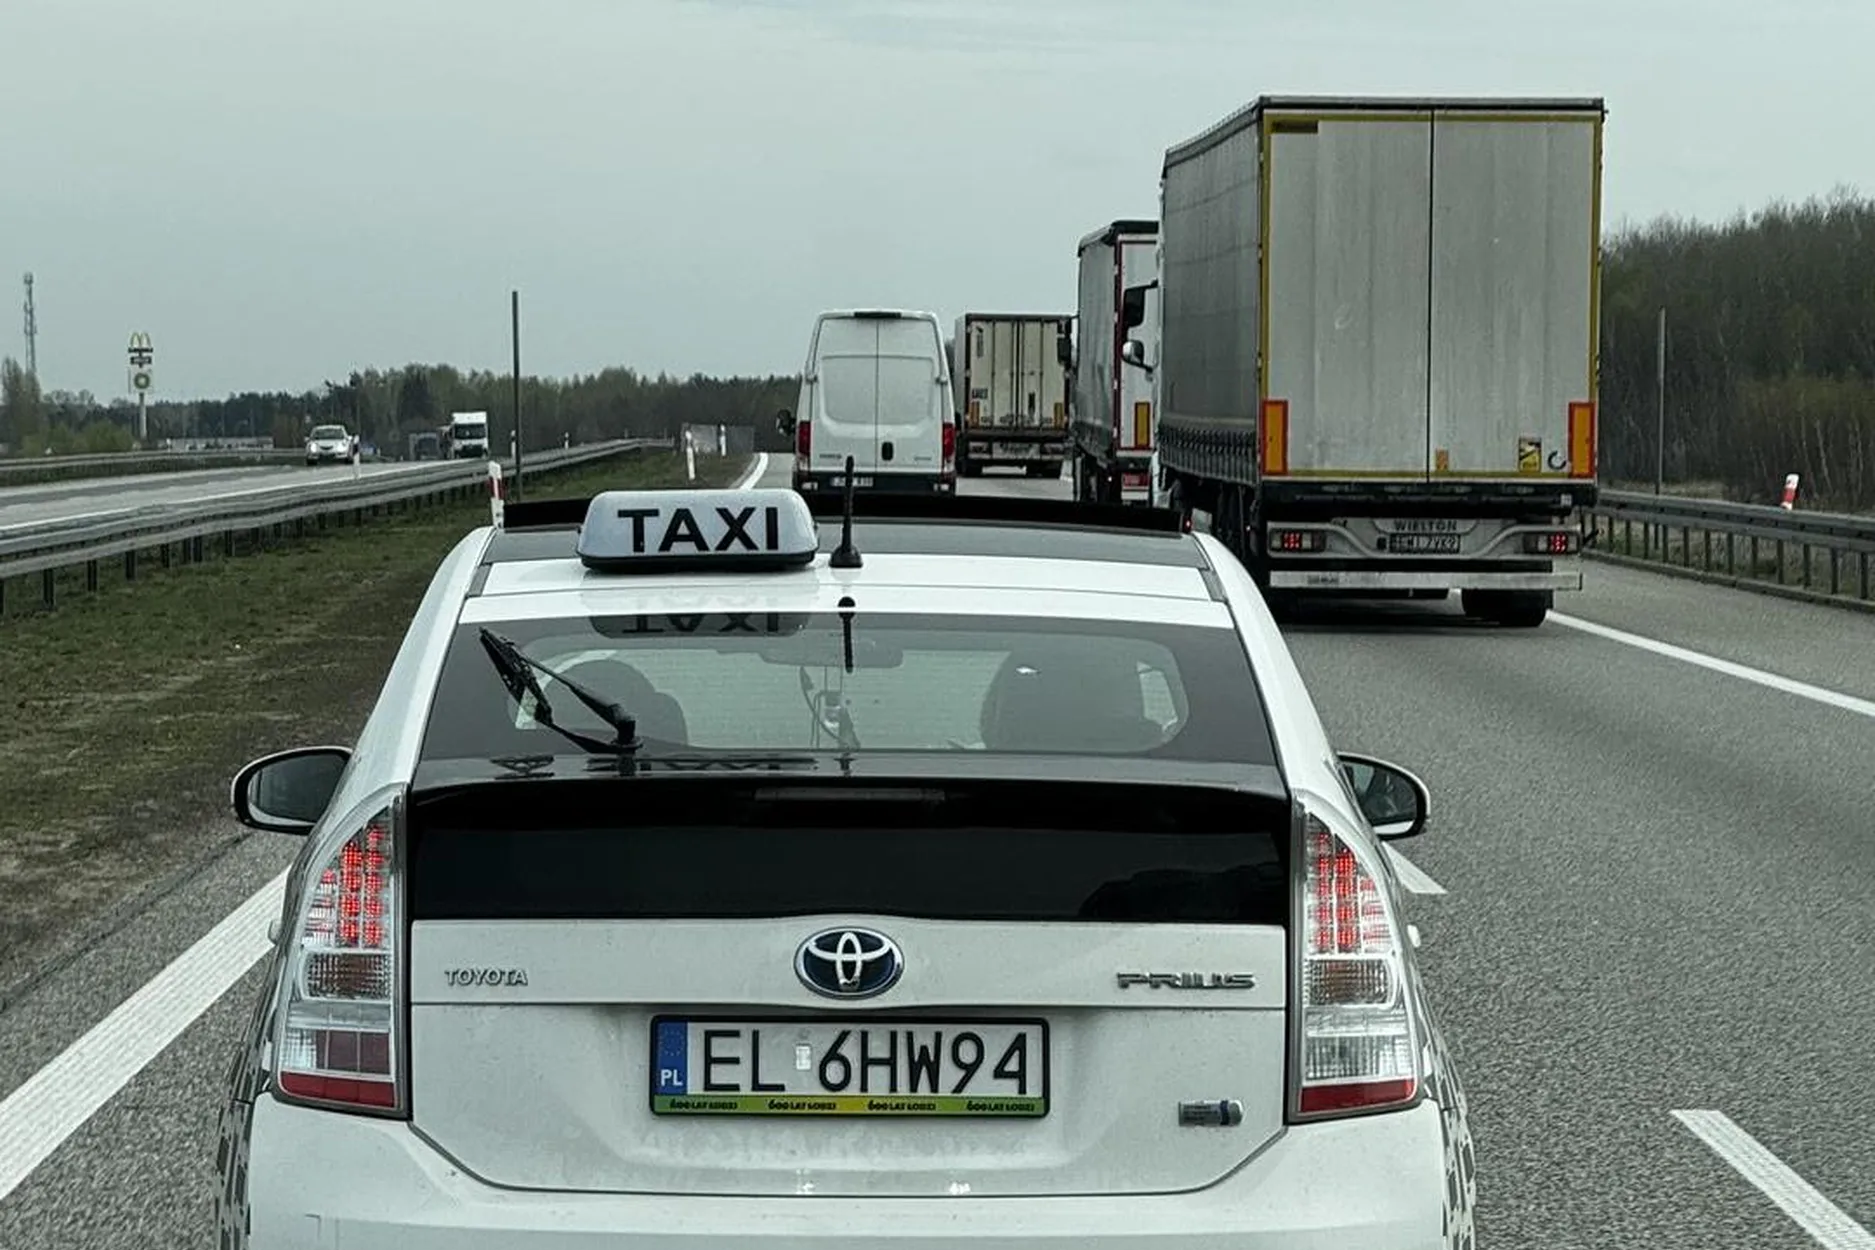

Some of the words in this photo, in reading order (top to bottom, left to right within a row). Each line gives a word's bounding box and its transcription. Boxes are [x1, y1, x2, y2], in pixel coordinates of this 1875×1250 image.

[617, 507, 779, 553] TAXI
[444, 967, 529, 987] TOYOTA
[1116, 972, 1256, 990] PRIUS
[703, 1029, 786, 1093] EL
[818, 1029, 1029, 1095] 6HW94
[660, 1069, 684, 1087] PL
